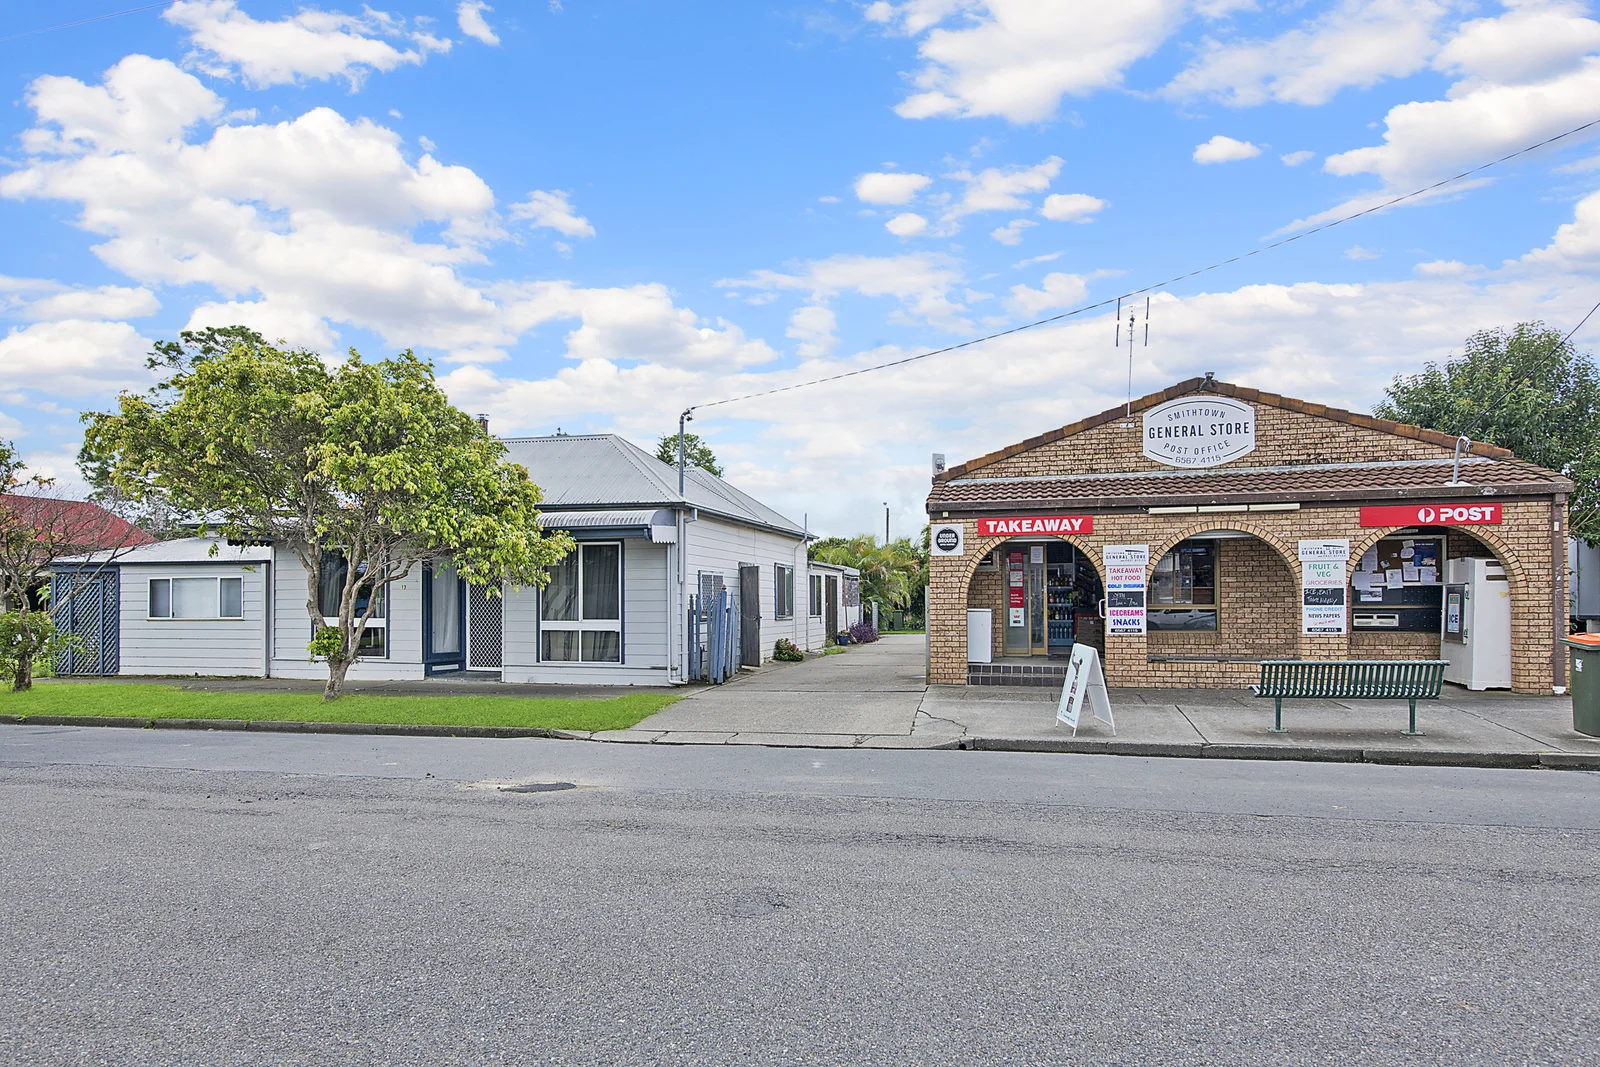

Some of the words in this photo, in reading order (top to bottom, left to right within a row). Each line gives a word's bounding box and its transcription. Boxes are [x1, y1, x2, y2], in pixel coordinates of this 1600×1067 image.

[1167, 408, 1226, 421] SMITHTOWN
[1148, 424, 1204, 439] GENERAL
[1210, 421, 1250, 436] STORE
[1163, 442, 1188, 455] POST
[1193, 439, 1231, 456] OFFICE
[1175, 456, 1197, 465] 6567
[1200, 454, 1222, 464] 4115
[1439, 506, 1495, 522] POST
[985, 518, 1084, 533] TAKEAWAY
[1109, 609, 1144, 617] ICECREAMS
[1448, 614, 1458, 623] ICE
[1112, 618, 1141, 626] SNACKS
